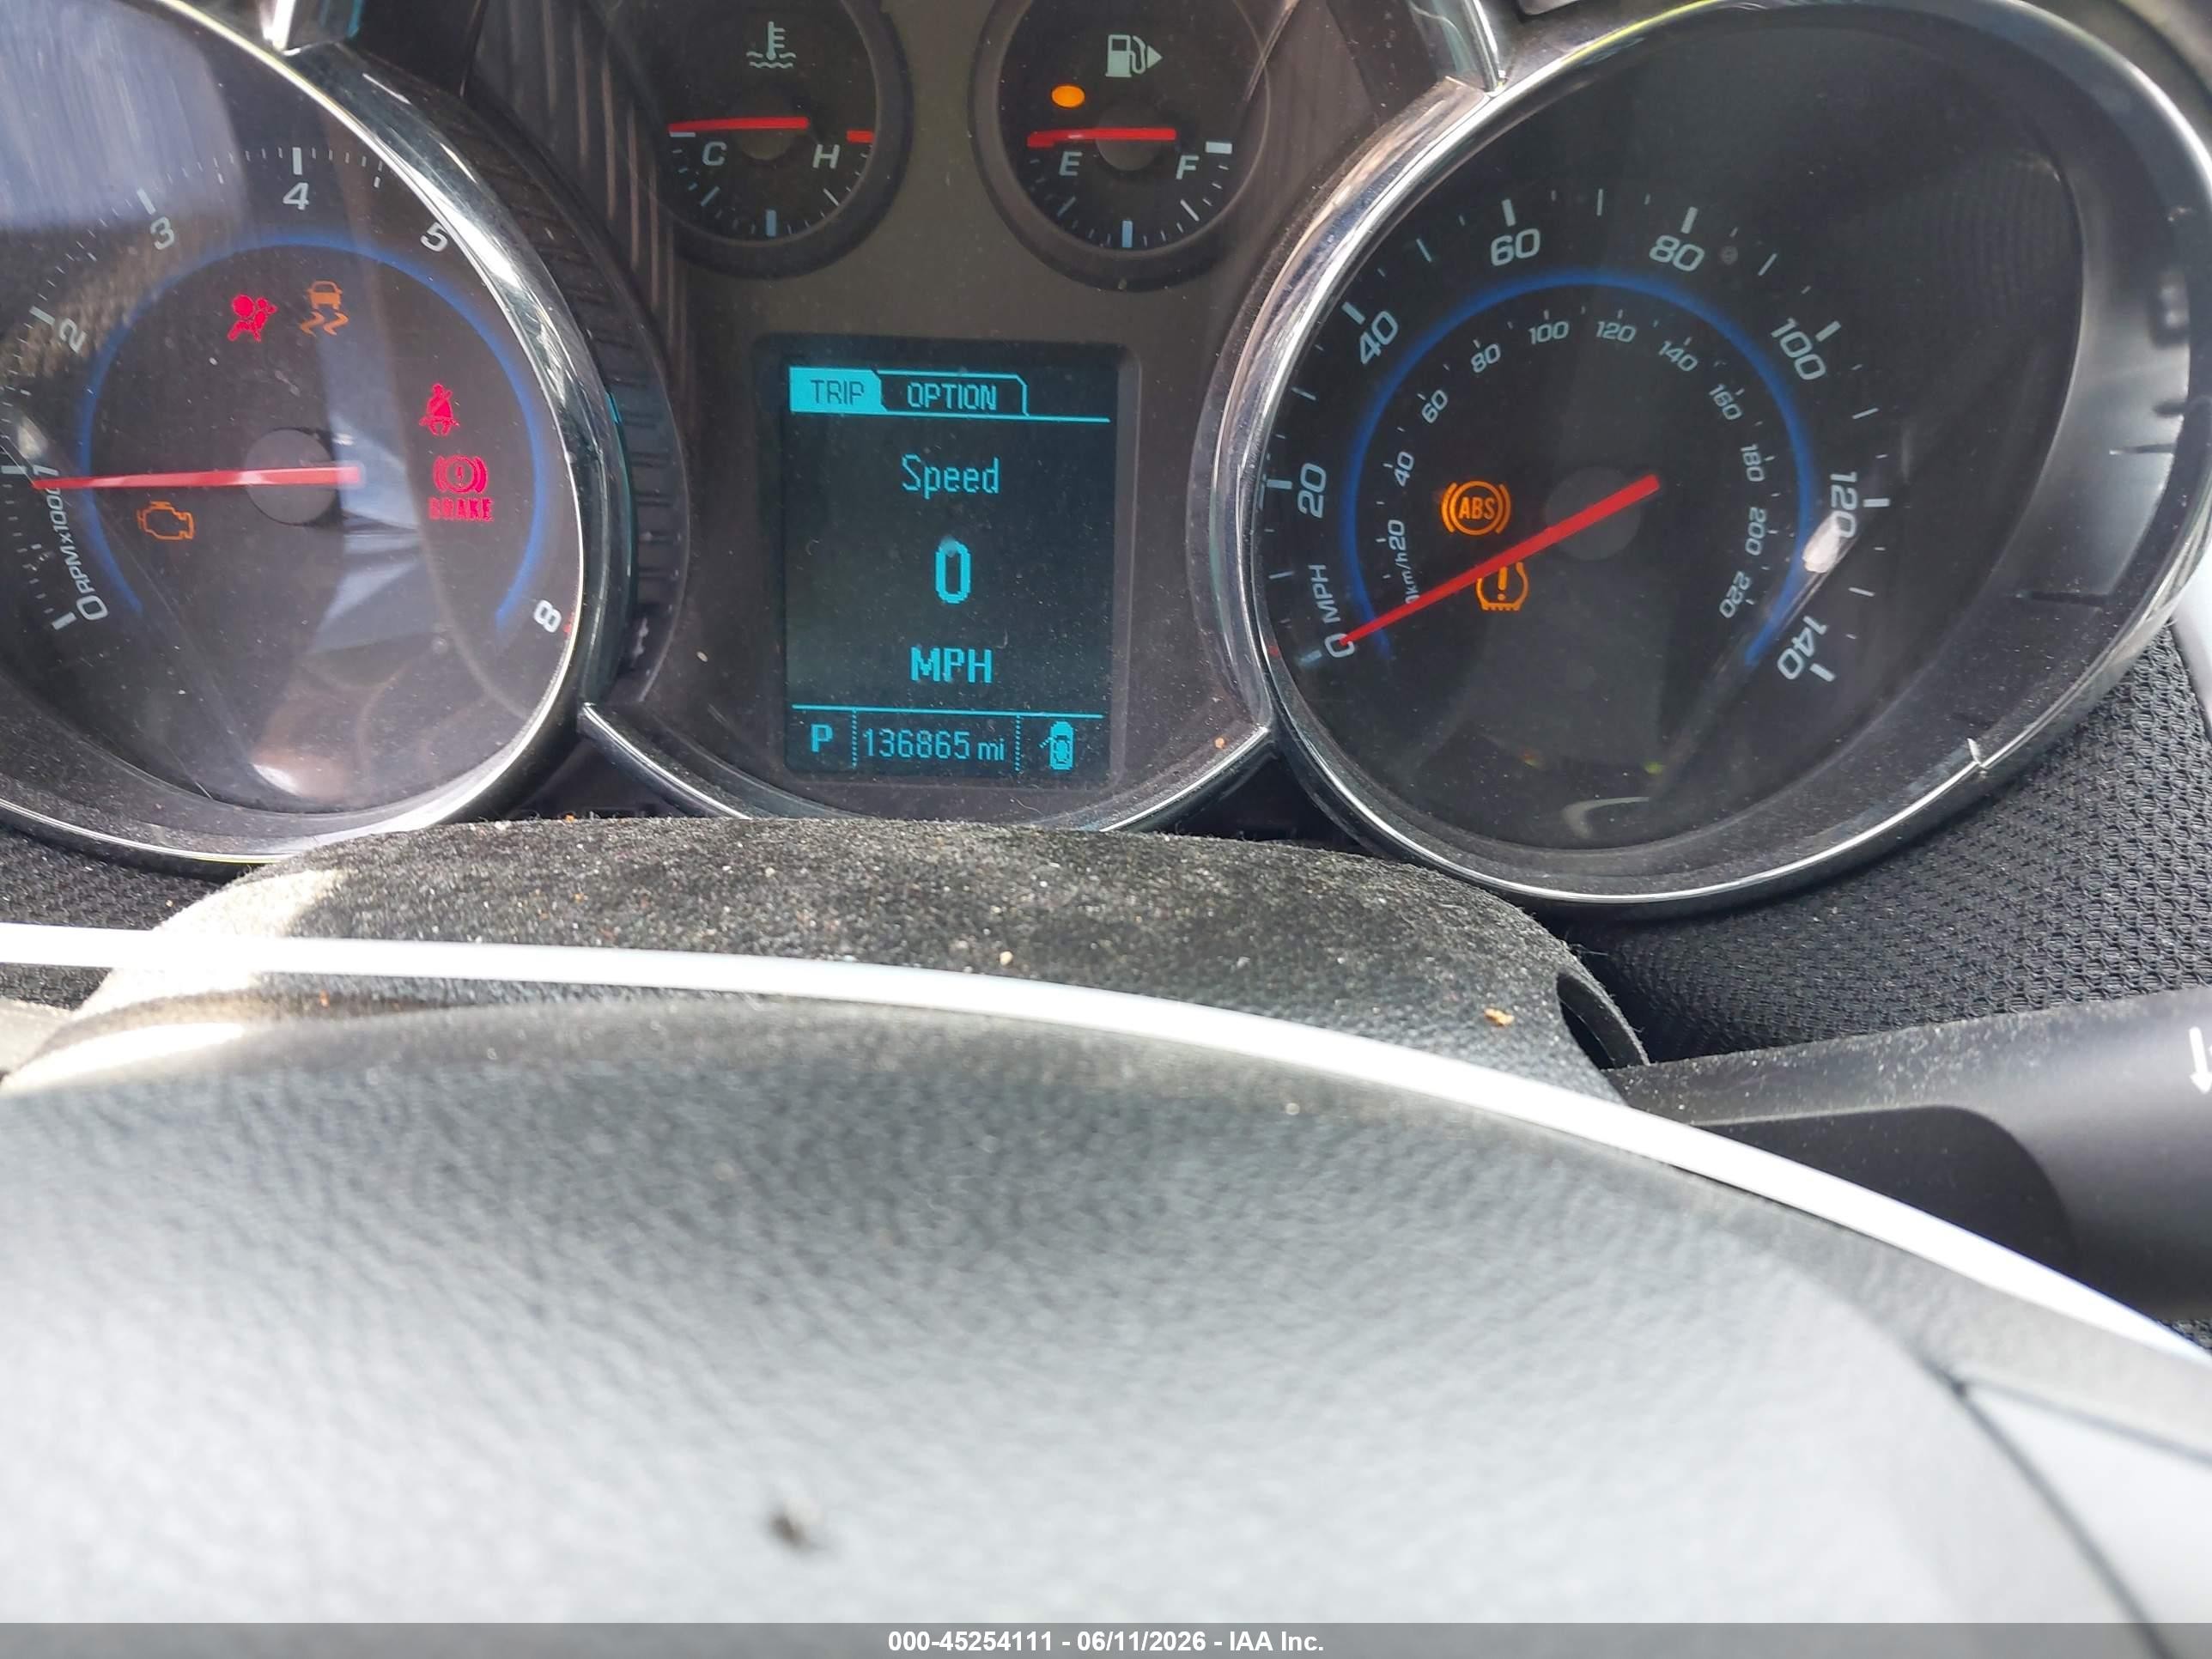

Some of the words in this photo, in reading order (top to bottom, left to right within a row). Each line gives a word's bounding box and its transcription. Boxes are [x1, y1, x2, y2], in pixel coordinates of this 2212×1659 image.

[702, 142, 727, 167] C
[813, 144, 840, 170] H
[1059, 151, 1083, 177] E
[1176, 155, 1200, 180] F
[283, 180, 310, 210] 4
[150, 218, 175, 250] 3
[420, 222, 449, 252] 5
[1490, 228, 1542, 267] 60
[1649, 234, 1705, 272] 80
[59, 324, 86, 353] 2
[1358, 310, 1400, 364] 40
[1528, 320, 1570, 344] 100
[1595, 320, 1636, 343] 120
[1470, 343, 1501, 373] 80
[1658, 341, 1698, 372] 140
[1771, 317, 1827, 380] 100
[810, 379, 865, 406] TRIP
[907, 382, 997, 410] OPTION
[1421, 390, 1448, 423] 60
[1709, 384, 1742, 421] 160
[901, 453, 1000, 500] Speed
[1394, 451, 1414, 487] 40
[1740, 444, 1765, 483] 180
[1297, 462, 1327, 519] 20
[1830, 471, 1858, 538] 120
[428, 497, 494, 522] BRAKE
[1458, 496, 1496, 520] ABS
[1388, 520, 1406, 550] 20
[1745, 507, 1766, 556] 200
[934, 538, 971, 604] 0
[76, 594, 109, 621] 0
[1309, 564, 1340, 623] MPH
[1719, 571, 1751, 619] 220
[533, 599, 562, 633] 8
[1324, 633, 1355, 659] 0
[1777, 616, 1828, 679] 140
[910, 647, 993, 684] MPH
[811, 724, 833, 753] P
[862, 728, 971, 761] 136865
[977, 739, 1006, 761] mi
